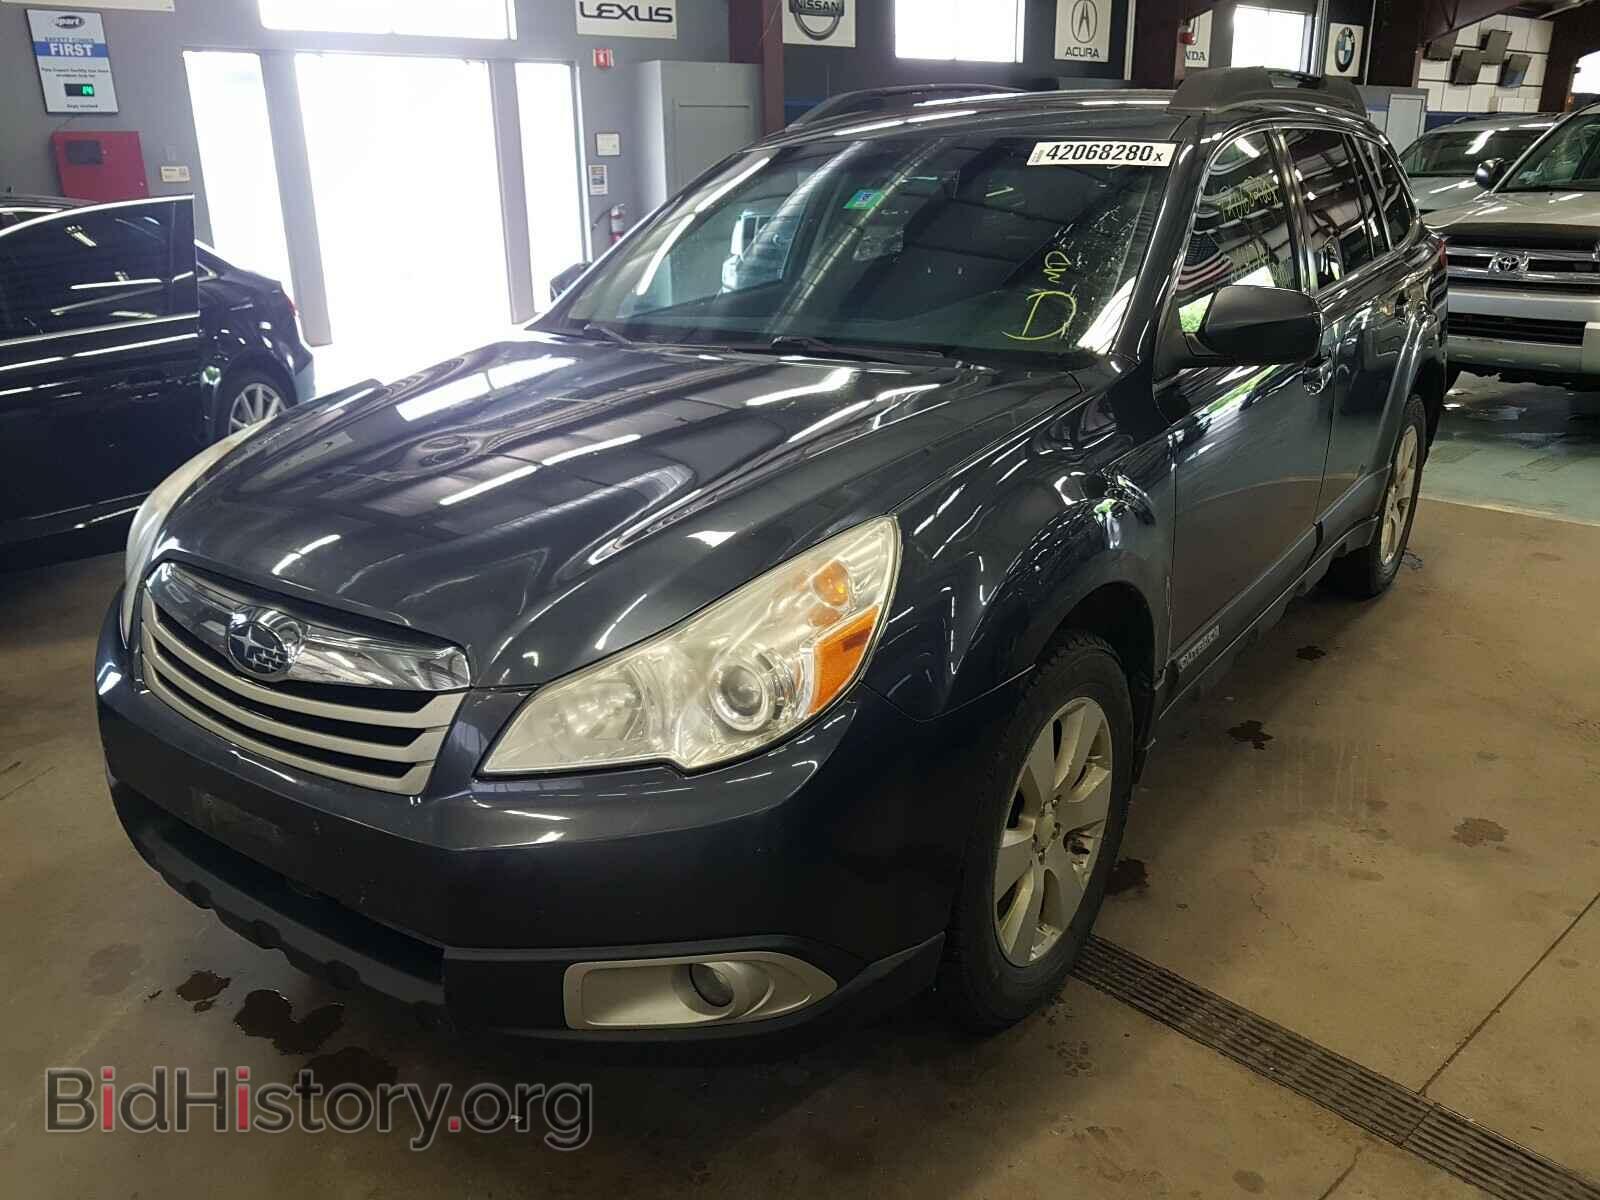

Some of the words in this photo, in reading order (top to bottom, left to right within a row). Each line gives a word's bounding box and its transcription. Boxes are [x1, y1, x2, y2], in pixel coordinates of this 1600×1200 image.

[580, 1, 673, 23] LEXUS
[792, 0, 840, 11] NISSAN
[49, 43, 94, 57] FIRST
[1065, 46, 1100, 58] ACURA
